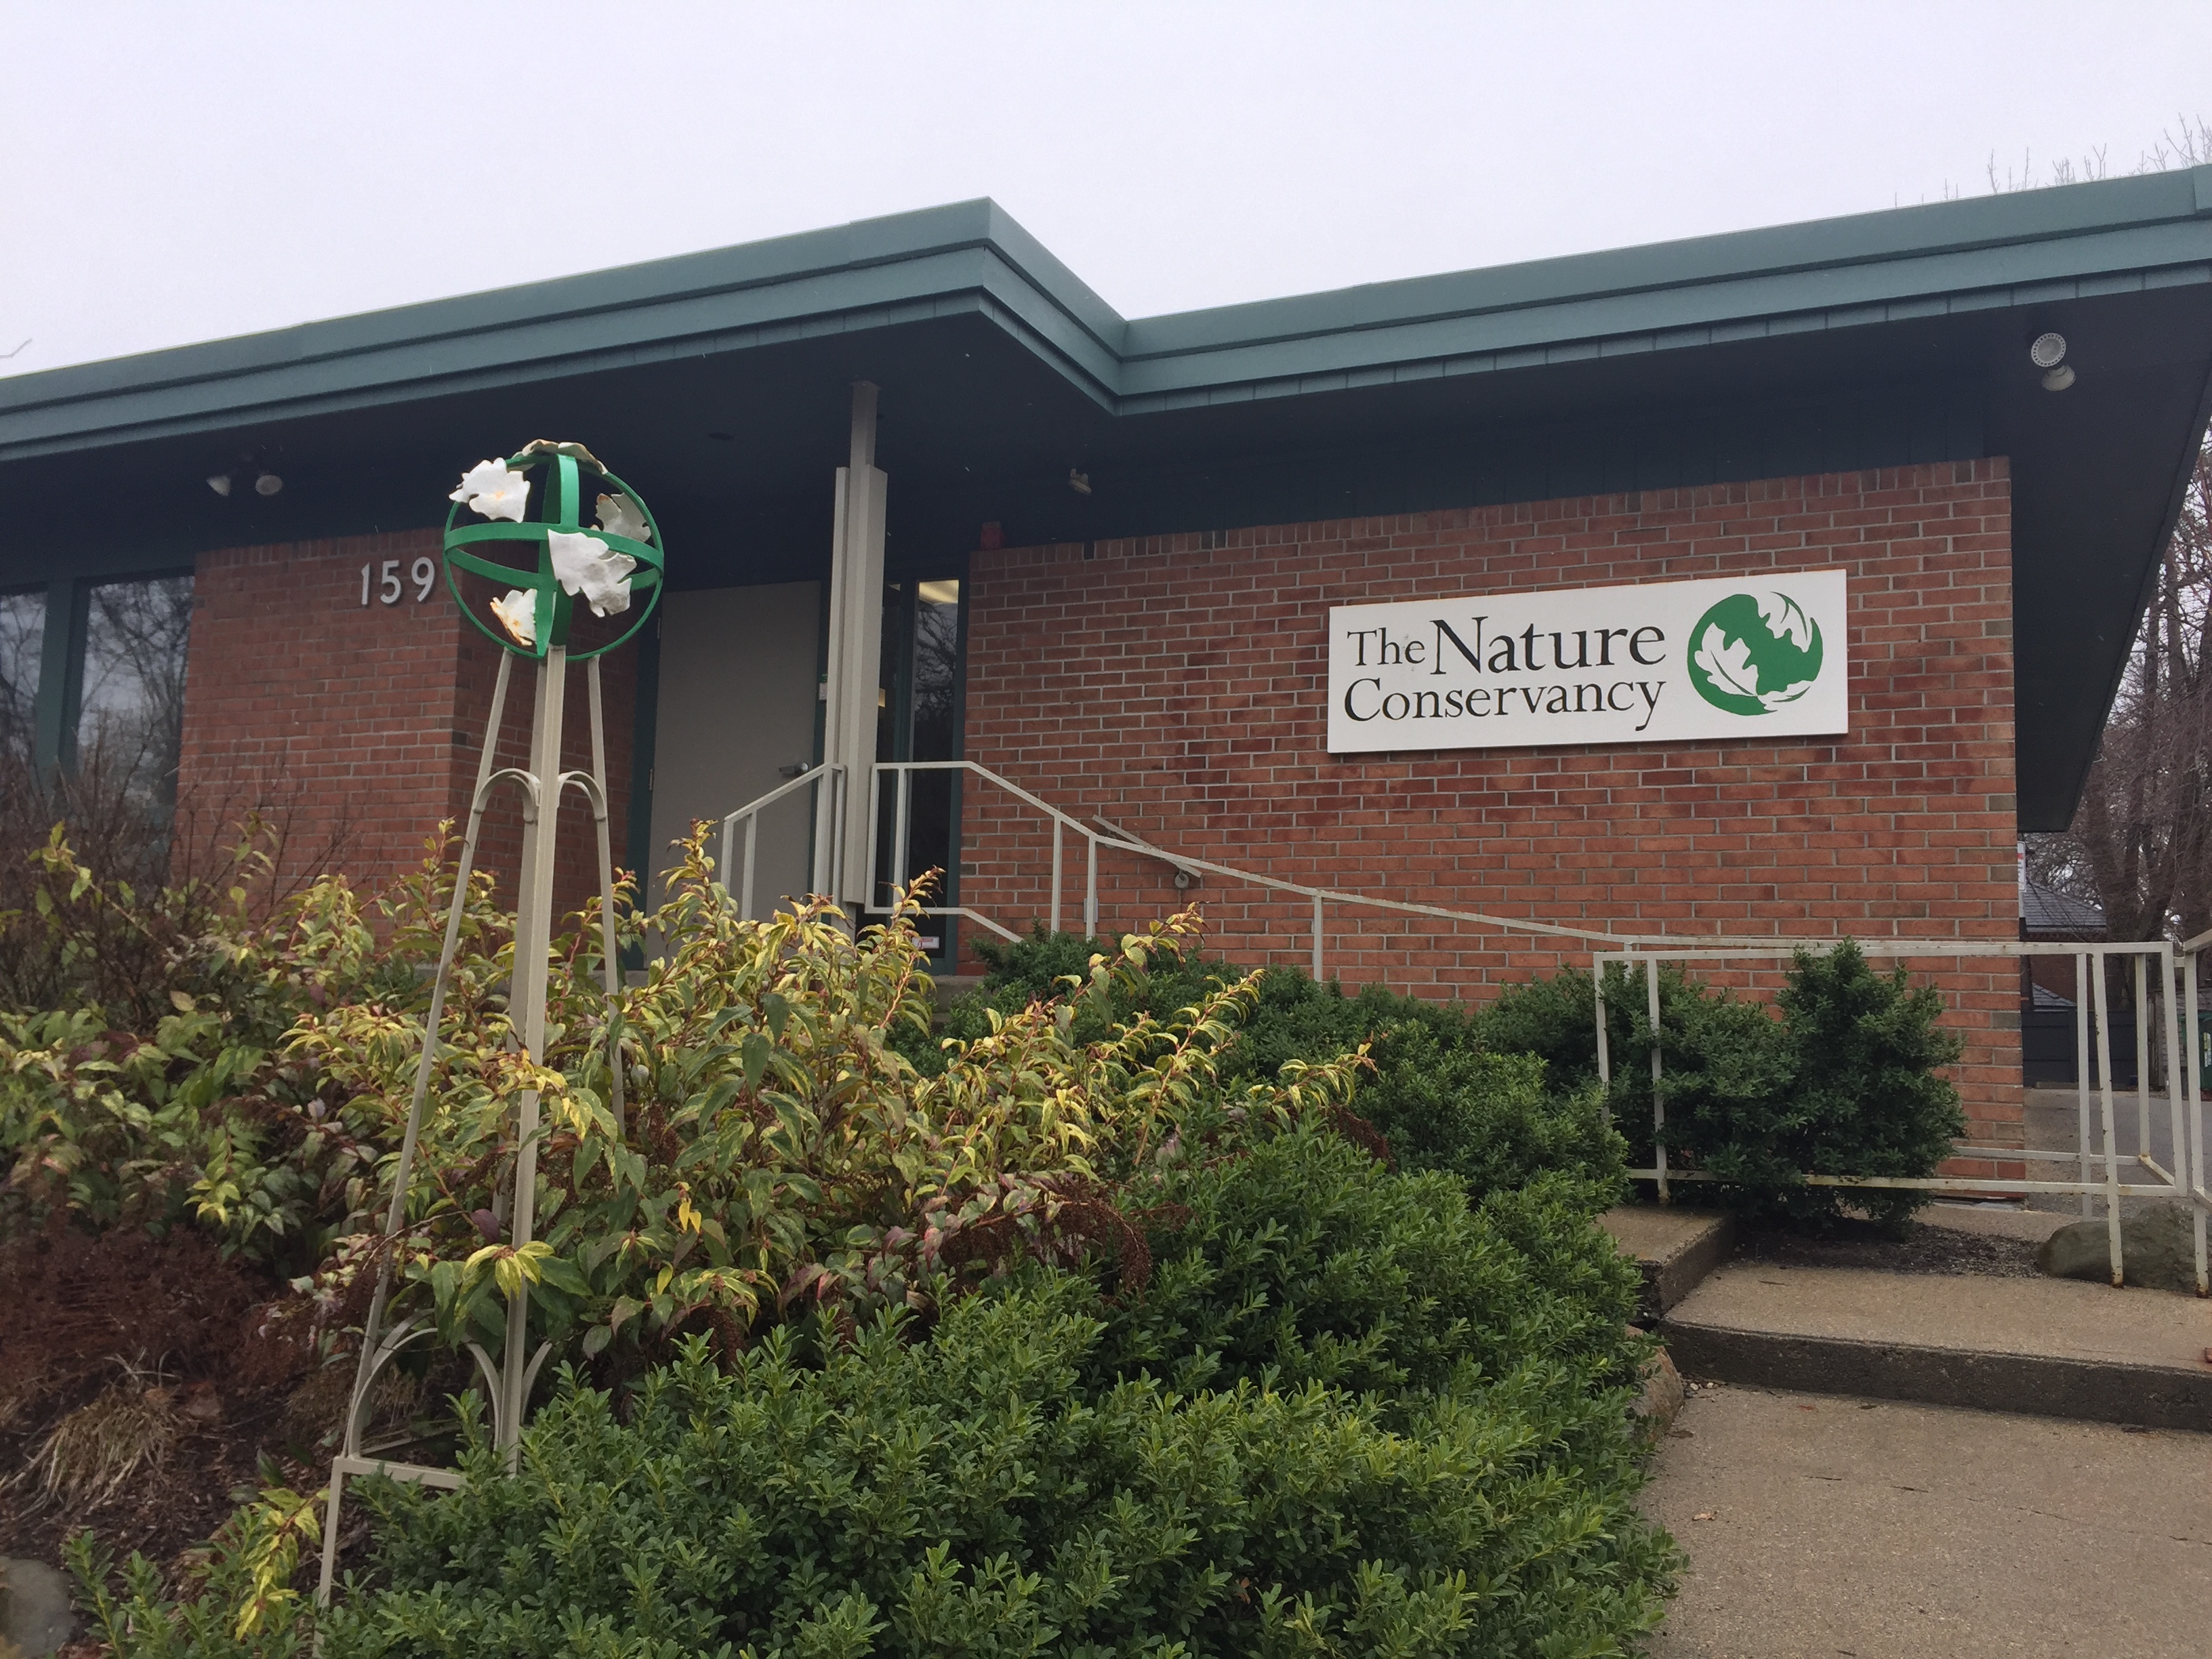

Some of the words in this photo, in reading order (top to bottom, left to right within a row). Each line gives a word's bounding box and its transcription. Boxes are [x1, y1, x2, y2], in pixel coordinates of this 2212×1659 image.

[361, 556, 435, 605] 159
[1347, 627, 1425, 666] The
[1430, 617, 1666, 674] Nature
[1345, 678, 1666, 731] Conservancy
